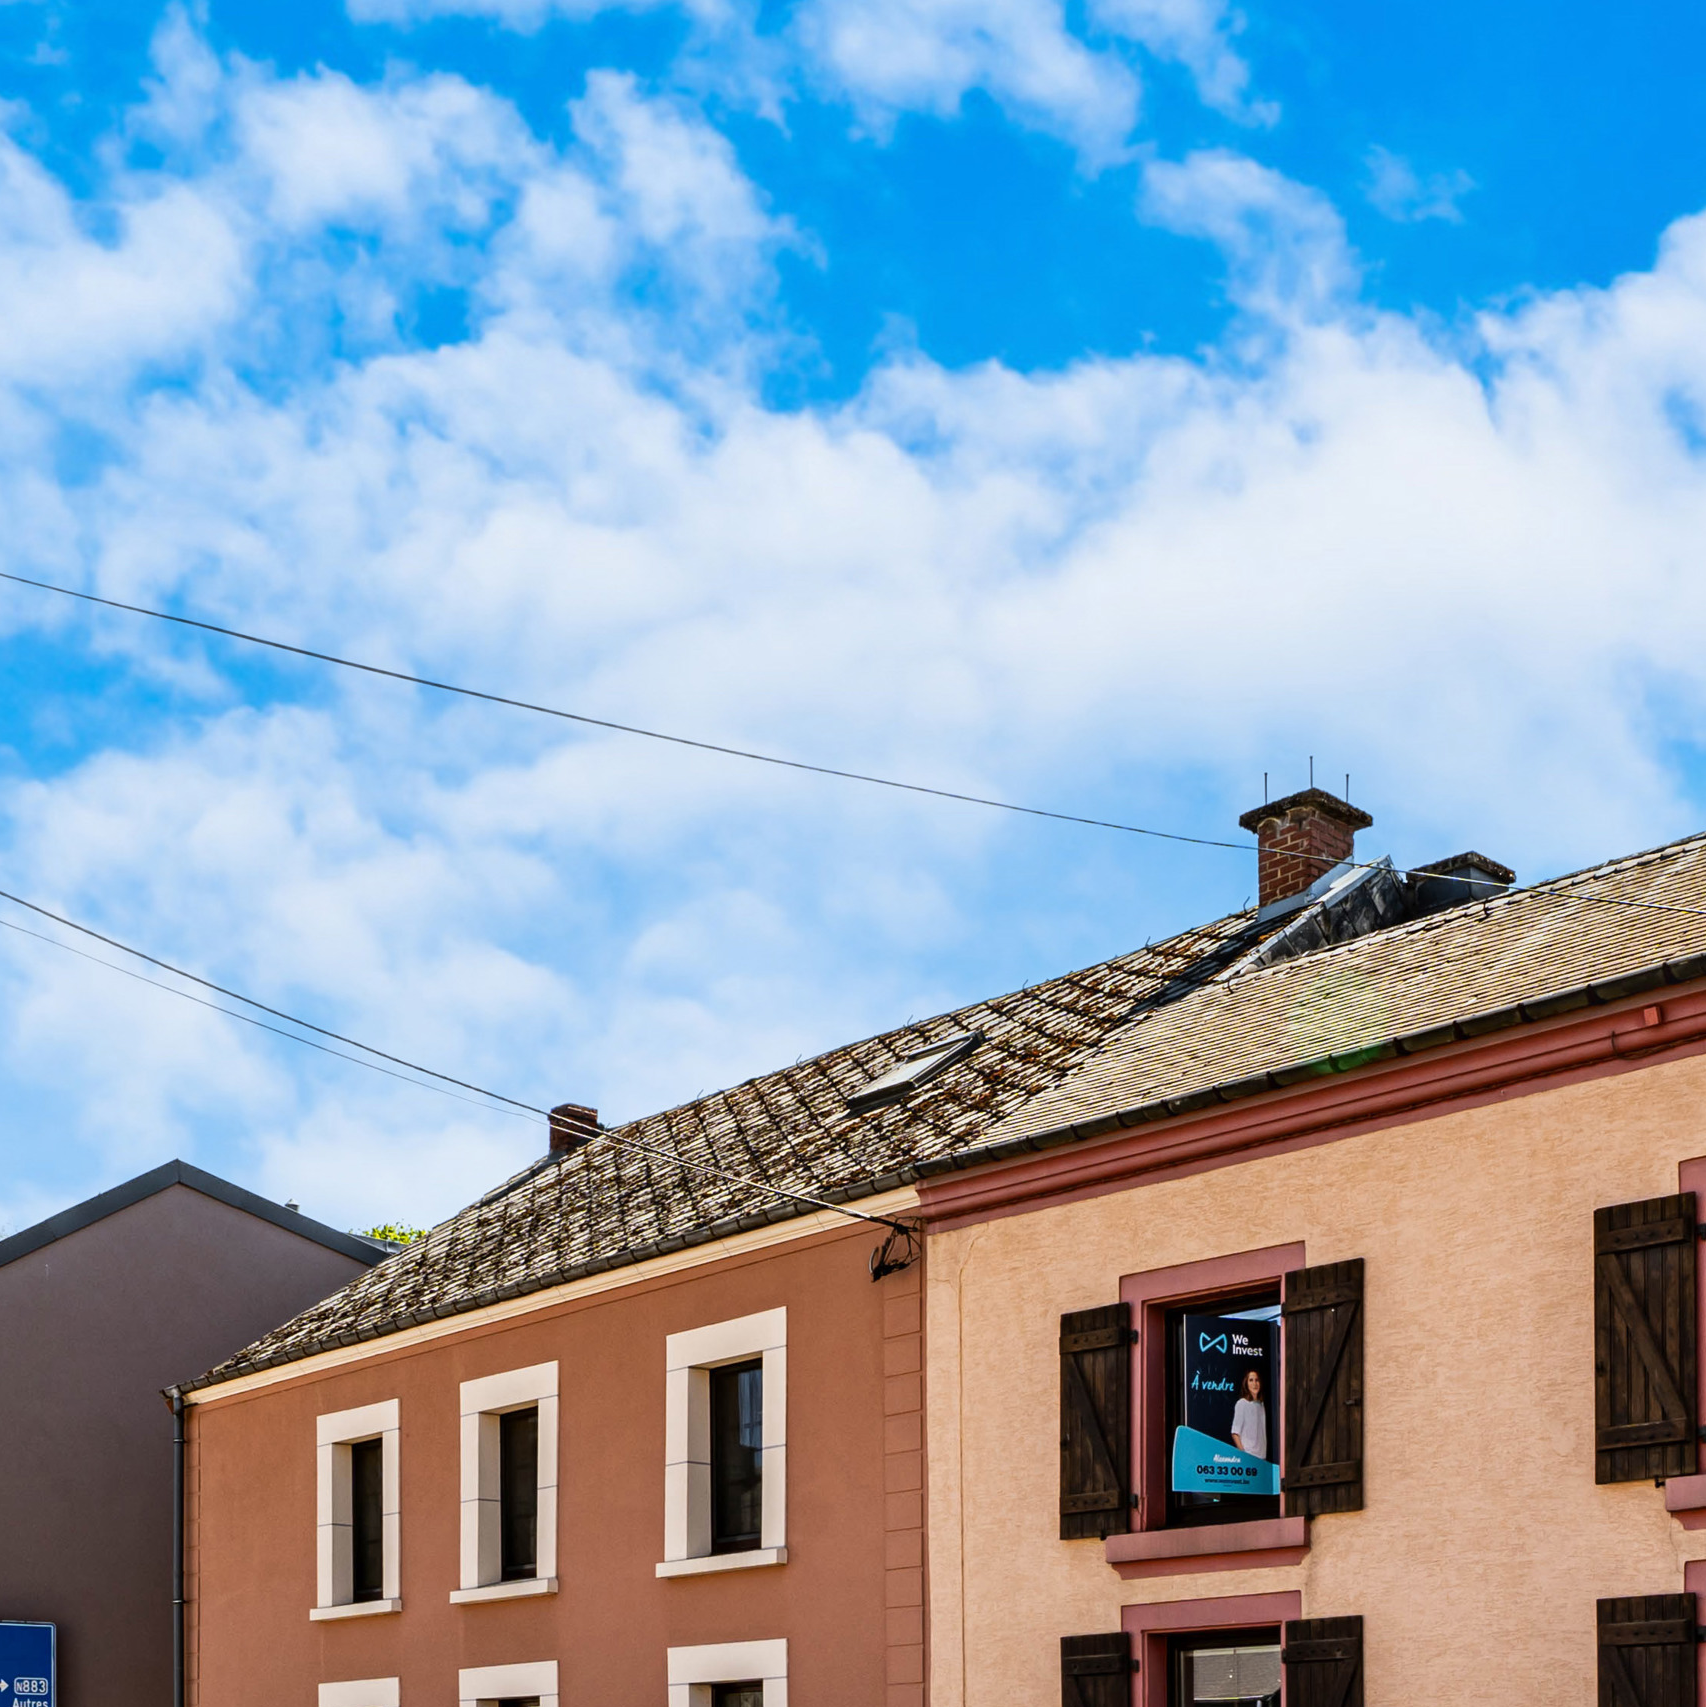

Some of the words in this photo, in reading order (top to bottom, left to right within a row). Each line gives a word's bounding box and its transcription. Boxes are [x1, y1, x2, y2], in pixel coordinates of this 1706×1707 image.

[1232, 1334, 1248, 1345] We
[1233, 1345, 1263, 1356] Invest
[1191, 1370, 1200, 1390] À
[1202, 1378, 1234, 1391] vendre
[1197, 1465, 1215, 1474] 063
[1217, 1466, 1228, 1475] 33
[1230, 1467, 1243, 1475] 00
[16, 1681, 46, 1693] N883
